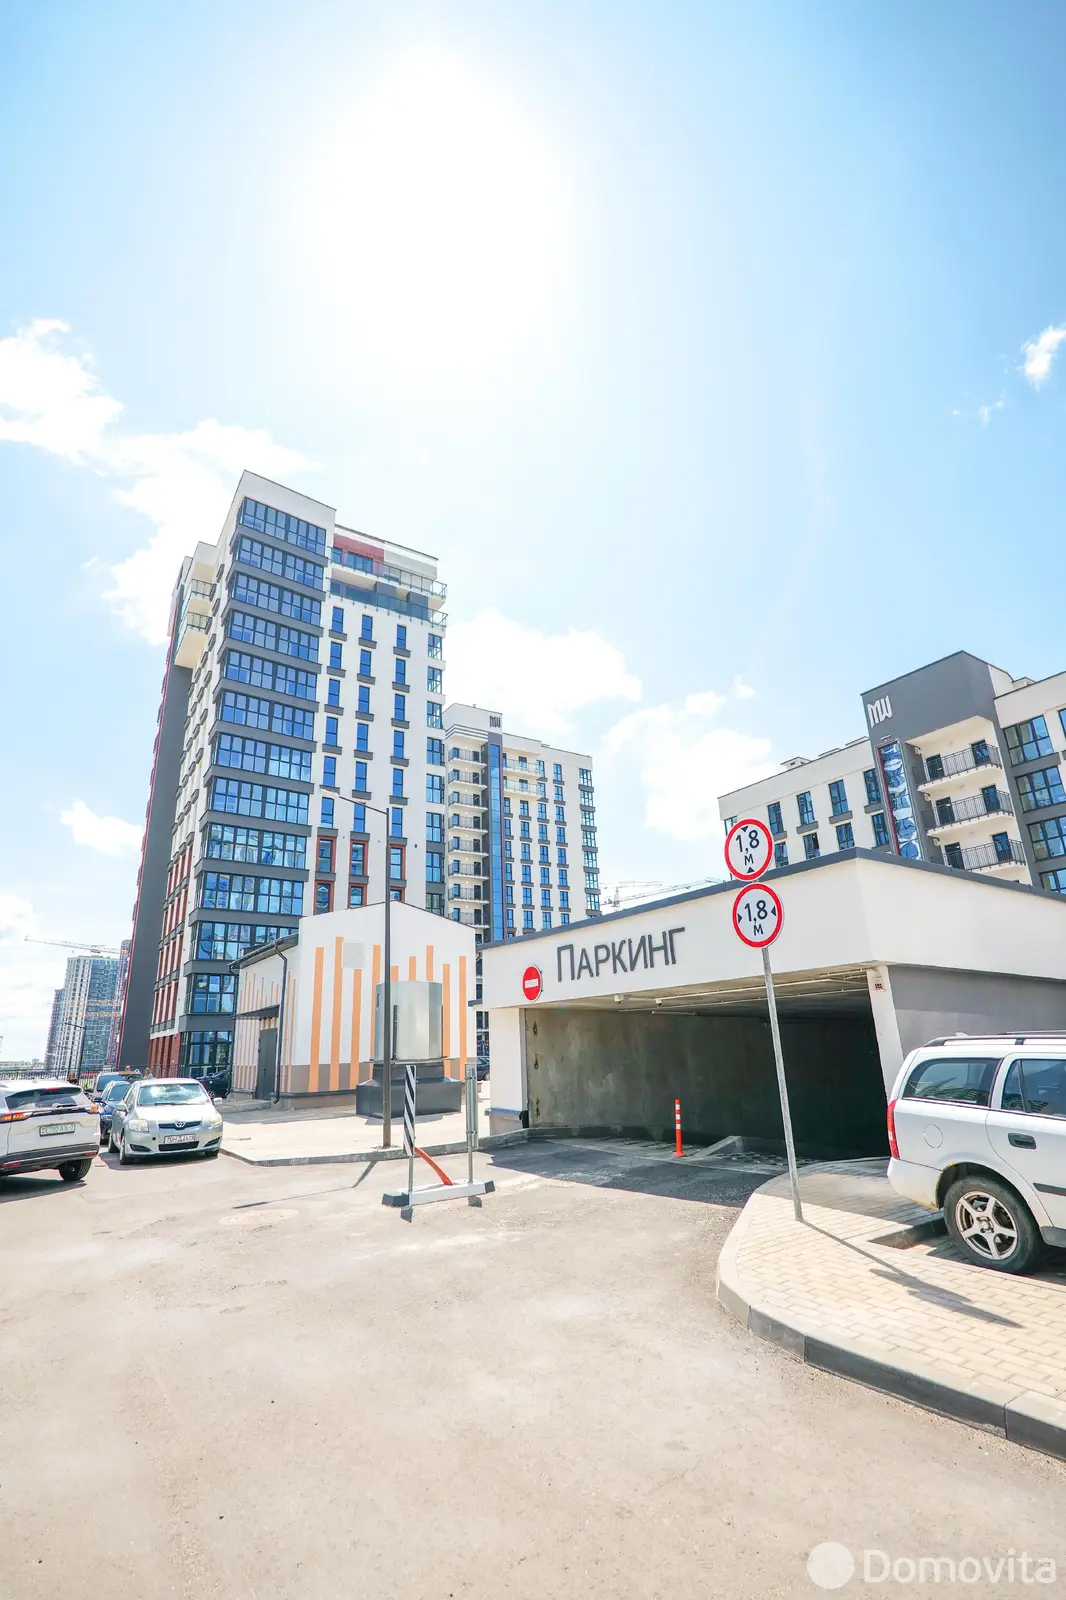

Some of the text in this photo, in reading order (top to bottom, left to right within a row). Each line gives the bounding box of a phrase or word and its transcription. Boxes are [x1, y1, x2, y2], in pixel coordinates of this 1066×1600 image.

[735, 829, 760, 854] 1,8
[744, 899, 768, 924] 1,8
[556, 926, 686, 983] ПАРКИНГ
